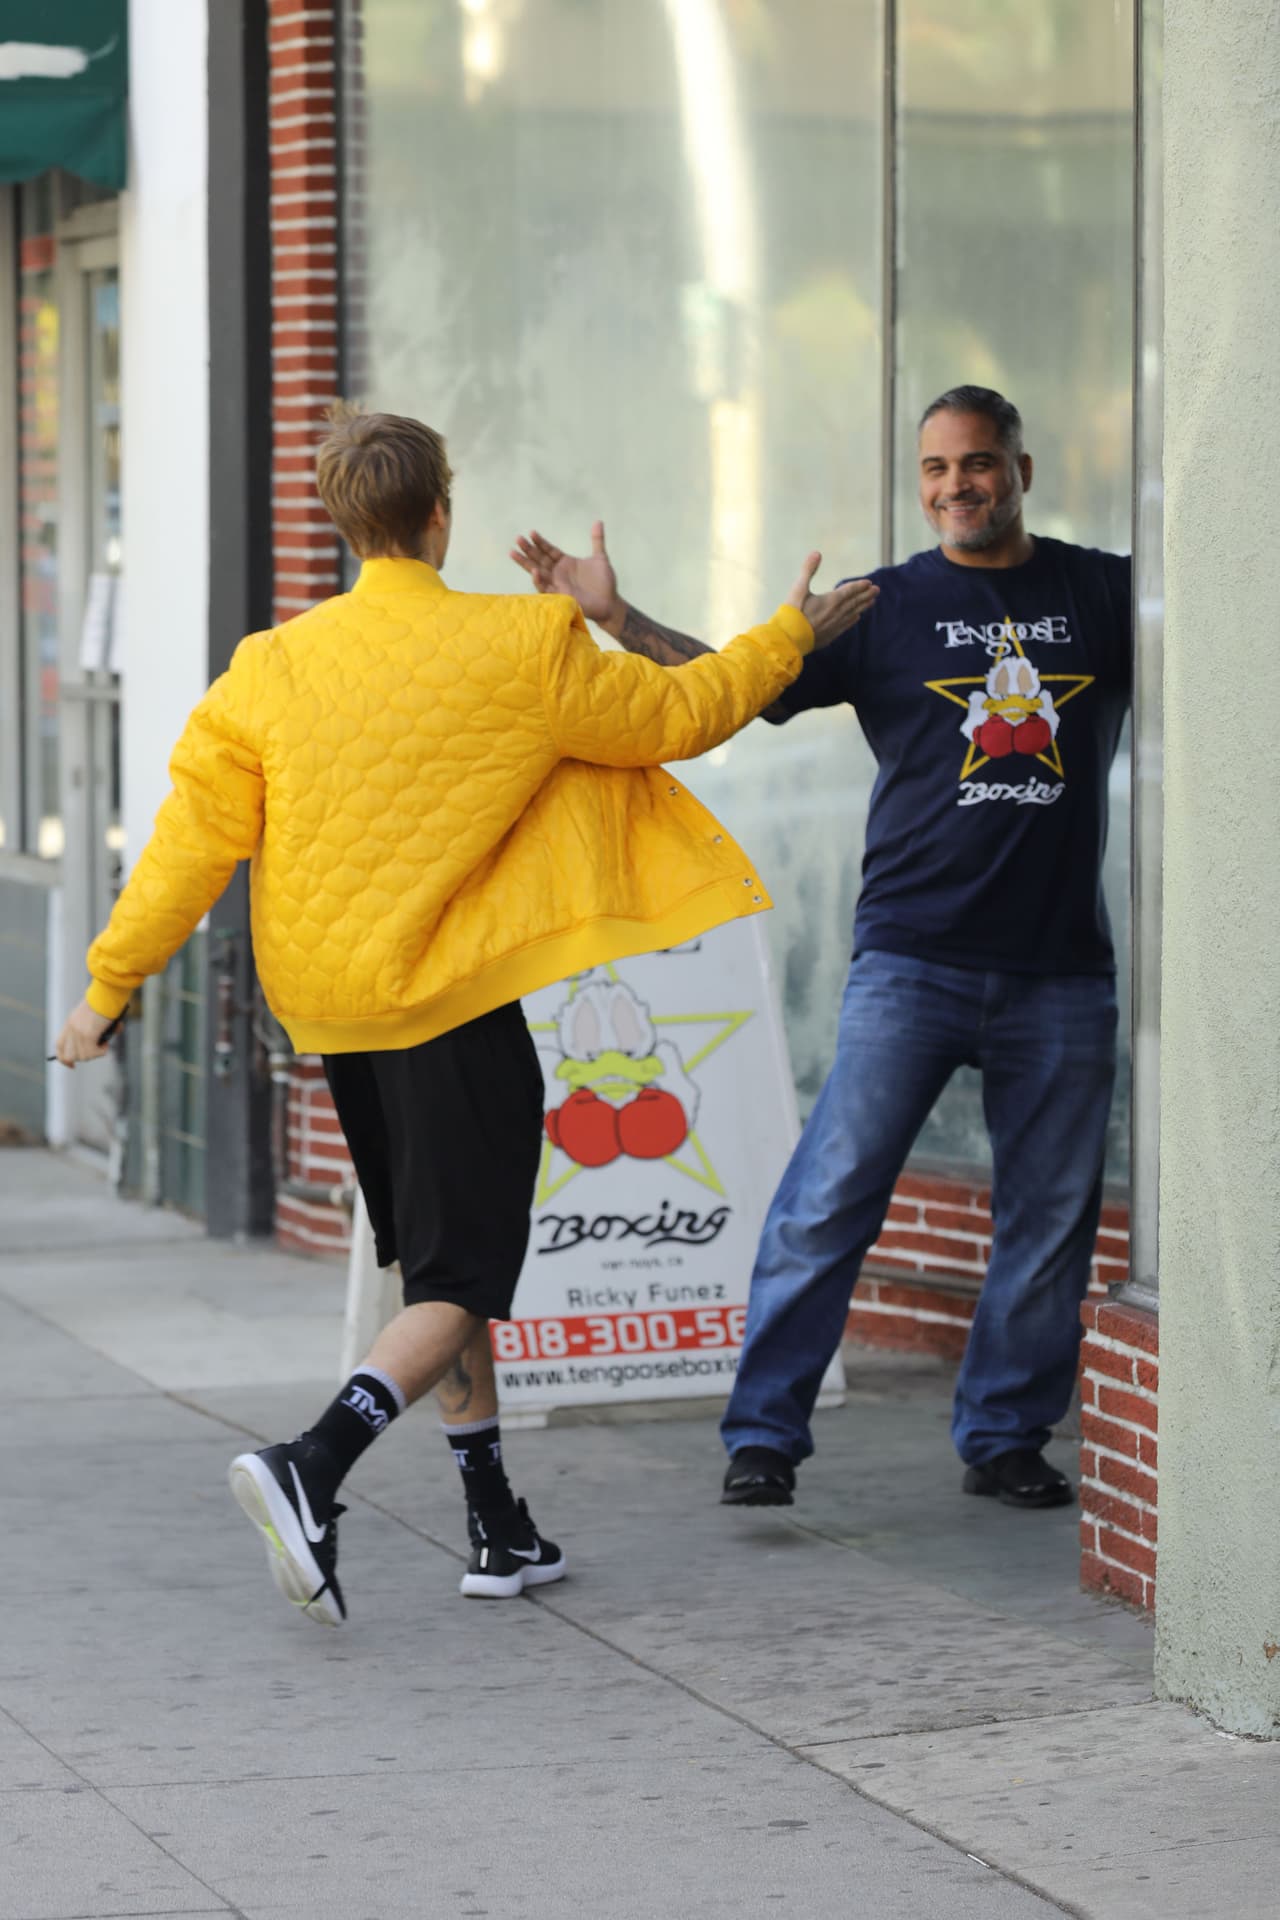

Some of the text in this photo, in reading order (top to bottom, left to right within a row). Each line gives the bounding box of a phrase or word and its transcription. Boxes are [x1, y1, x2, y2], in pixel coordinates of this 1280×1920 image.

[957, 776, 1066, 806] Boxing
[537, 1198, 733, 1255] Boxing
[567, 1282, 727, 1308] Ricky Funez
